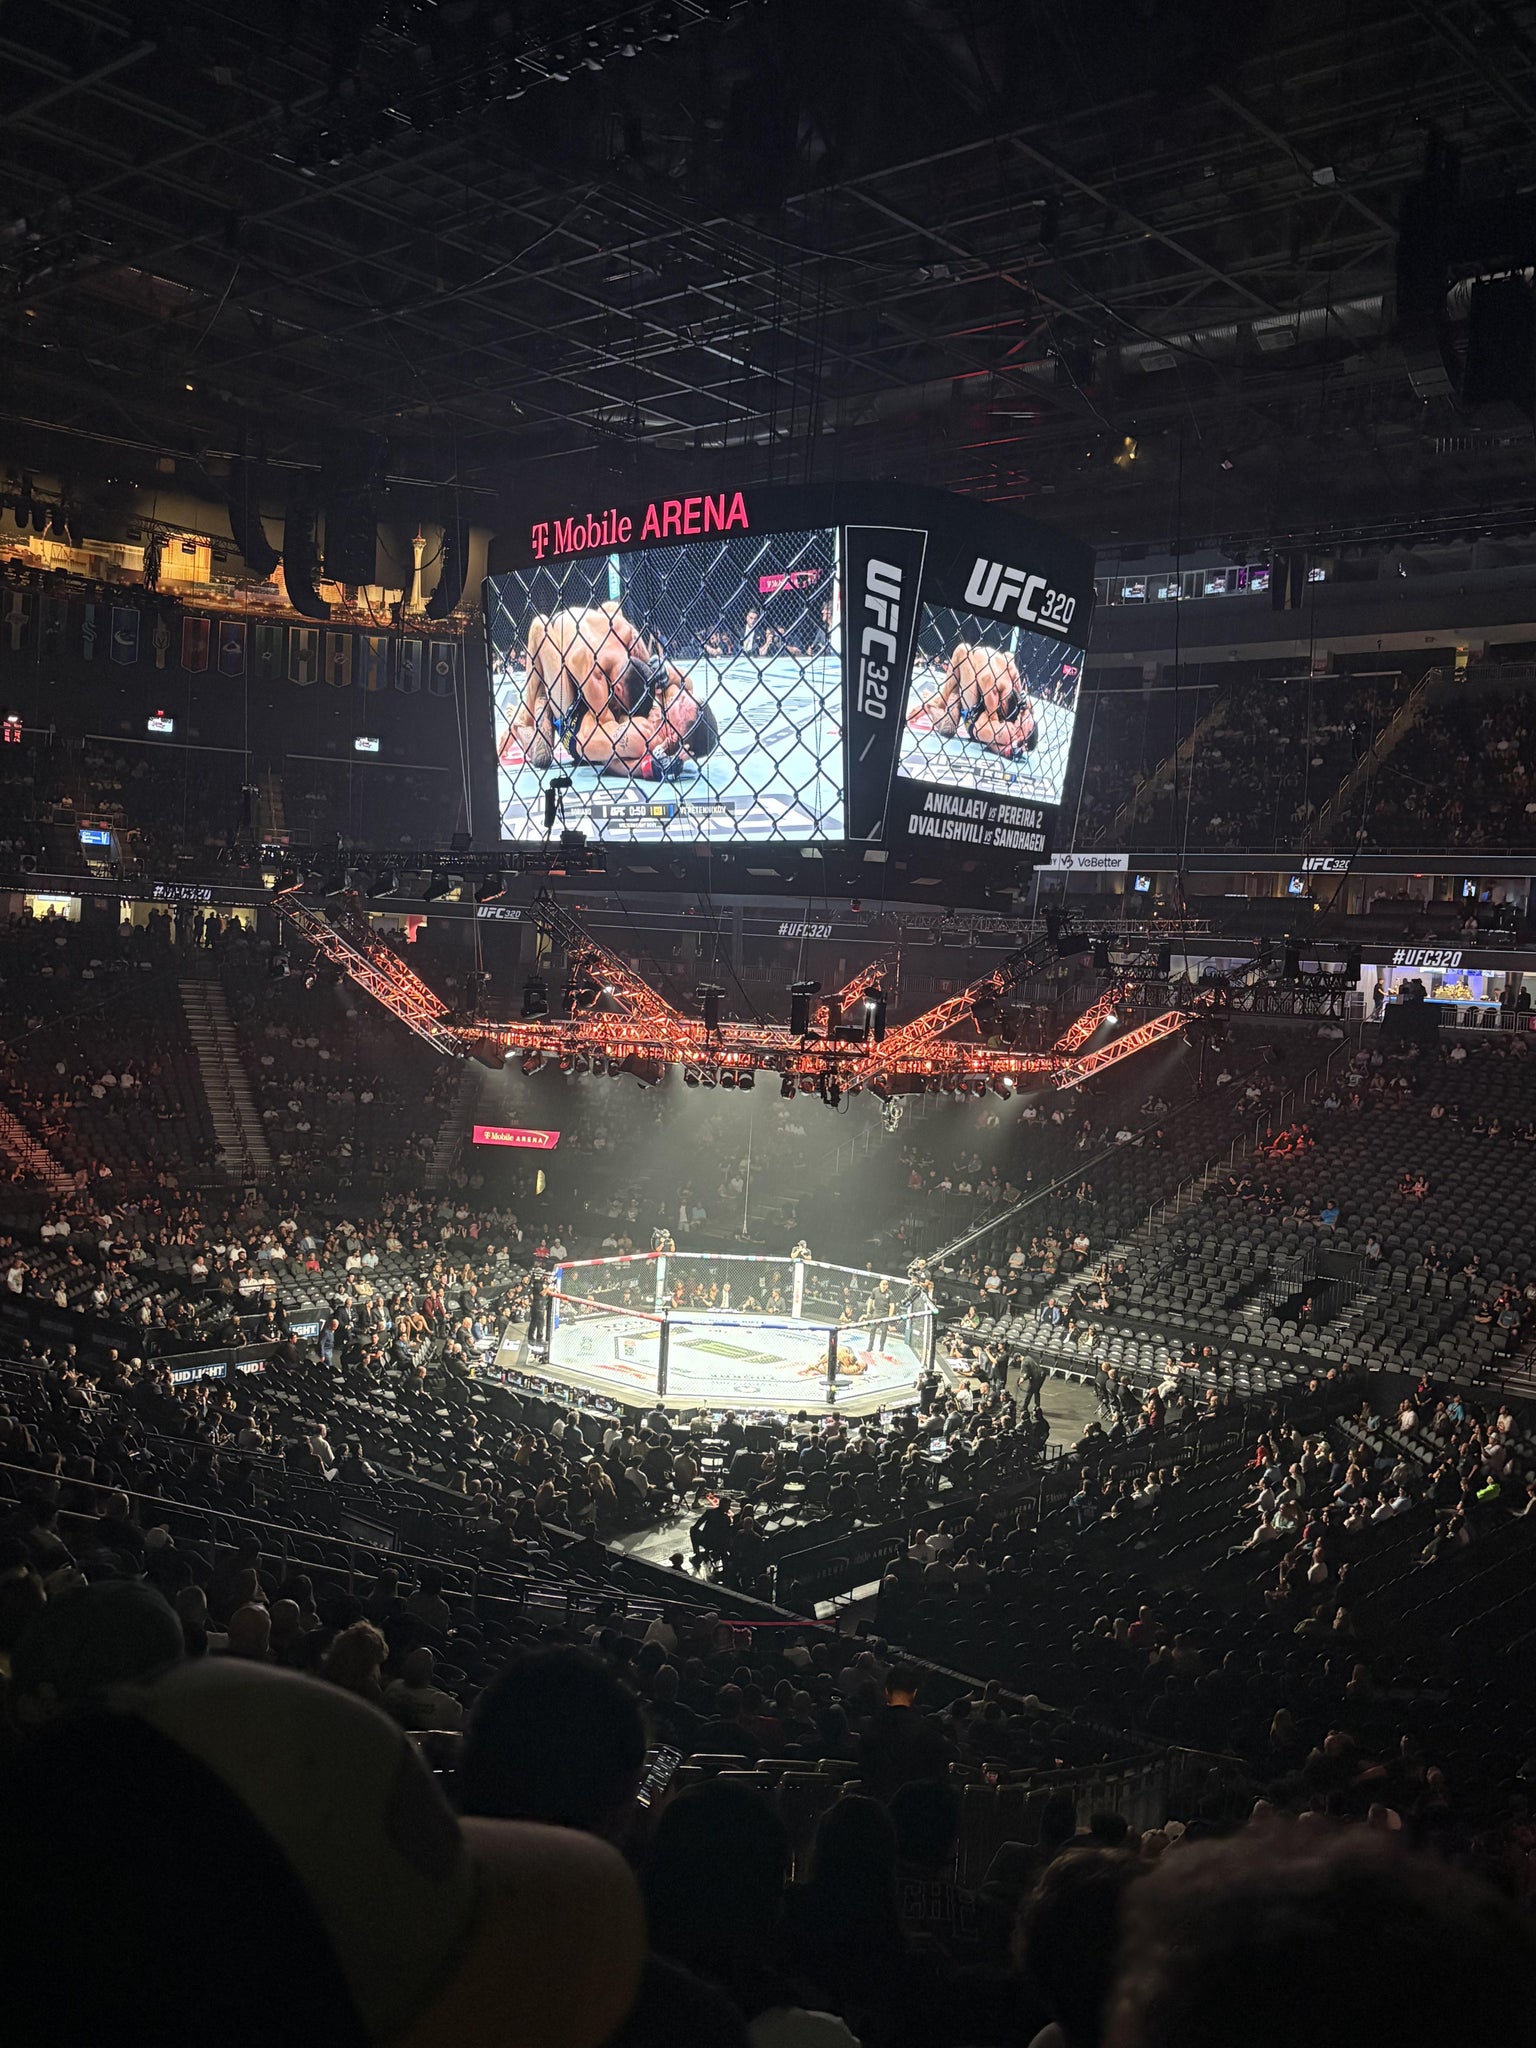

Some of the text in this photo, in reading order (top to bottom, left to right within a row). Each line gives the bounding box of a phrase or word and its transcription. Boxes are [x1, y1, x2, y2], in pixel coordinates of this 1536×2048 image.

[553, 508, 632, 556] Mobile
[640, 491, 750, 541] ARENA
[963, 557, 1077, 625] UFC 320
[861, 558, 903, 721] UFC 320
[923, 791, 989, 820] ANKALAEV
[997, 804, 1036, 828] PEREIRA
[1035, 810, 1044, 829] 2
[907, 814, 984, 845] DVALISHVILI
[993, 827, 1046, 853] SANDHAGEN
[1077, 856, 1122, 868] VeBetter
[1301, 857, 1333, 871] UFC
[477, 906, 506, 919] UFC
[1391, 948, 1464, 968] #UFC320
[515, 1136, 543, 1144] ARENA
